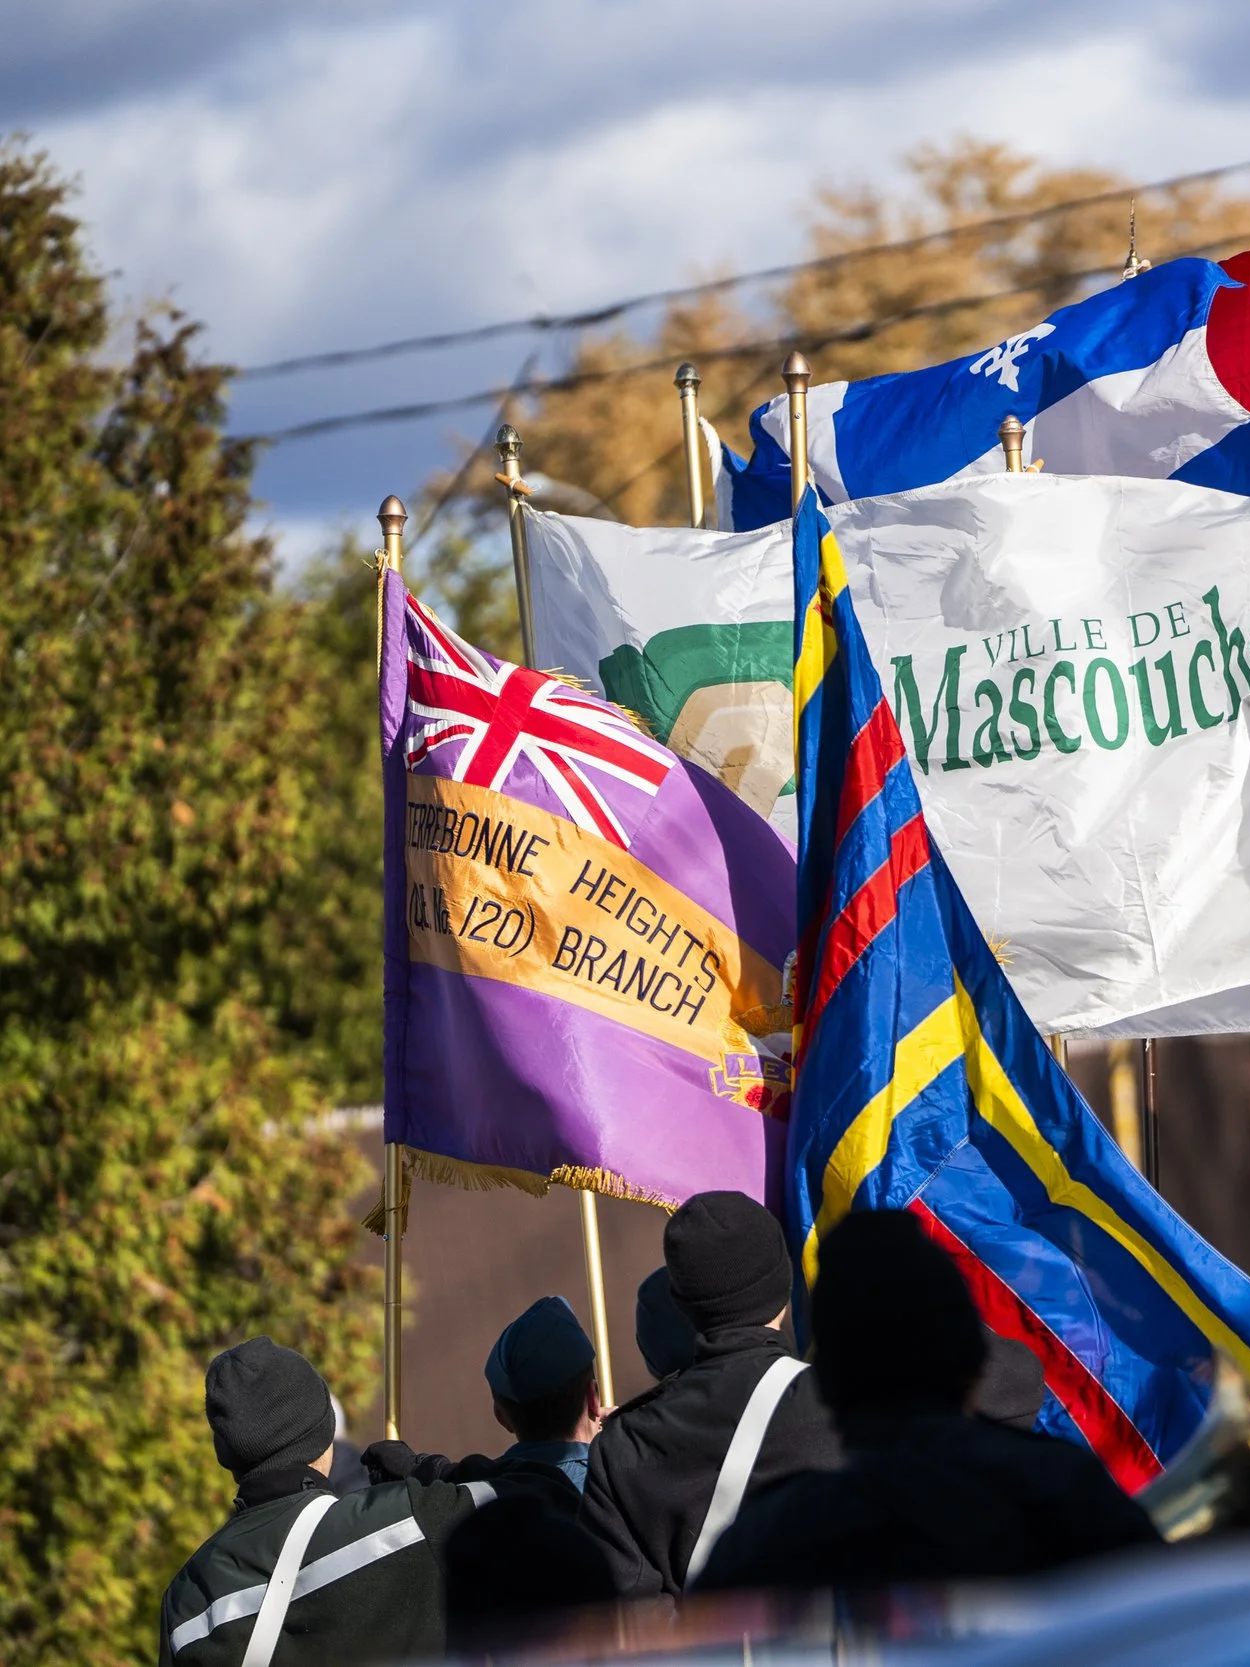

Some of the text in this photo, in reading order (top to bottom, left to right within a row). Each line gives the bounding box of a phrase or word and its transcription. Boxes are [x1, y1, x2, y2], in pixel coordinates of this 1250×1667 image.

[982, 601, 1191, 668] VILLE DE
[408, 802, 721, 993] TERREBONNE HEIGHTS
[458, 896, 535, 957] 120)
[551, 926, 706, 1025] BRANCH
